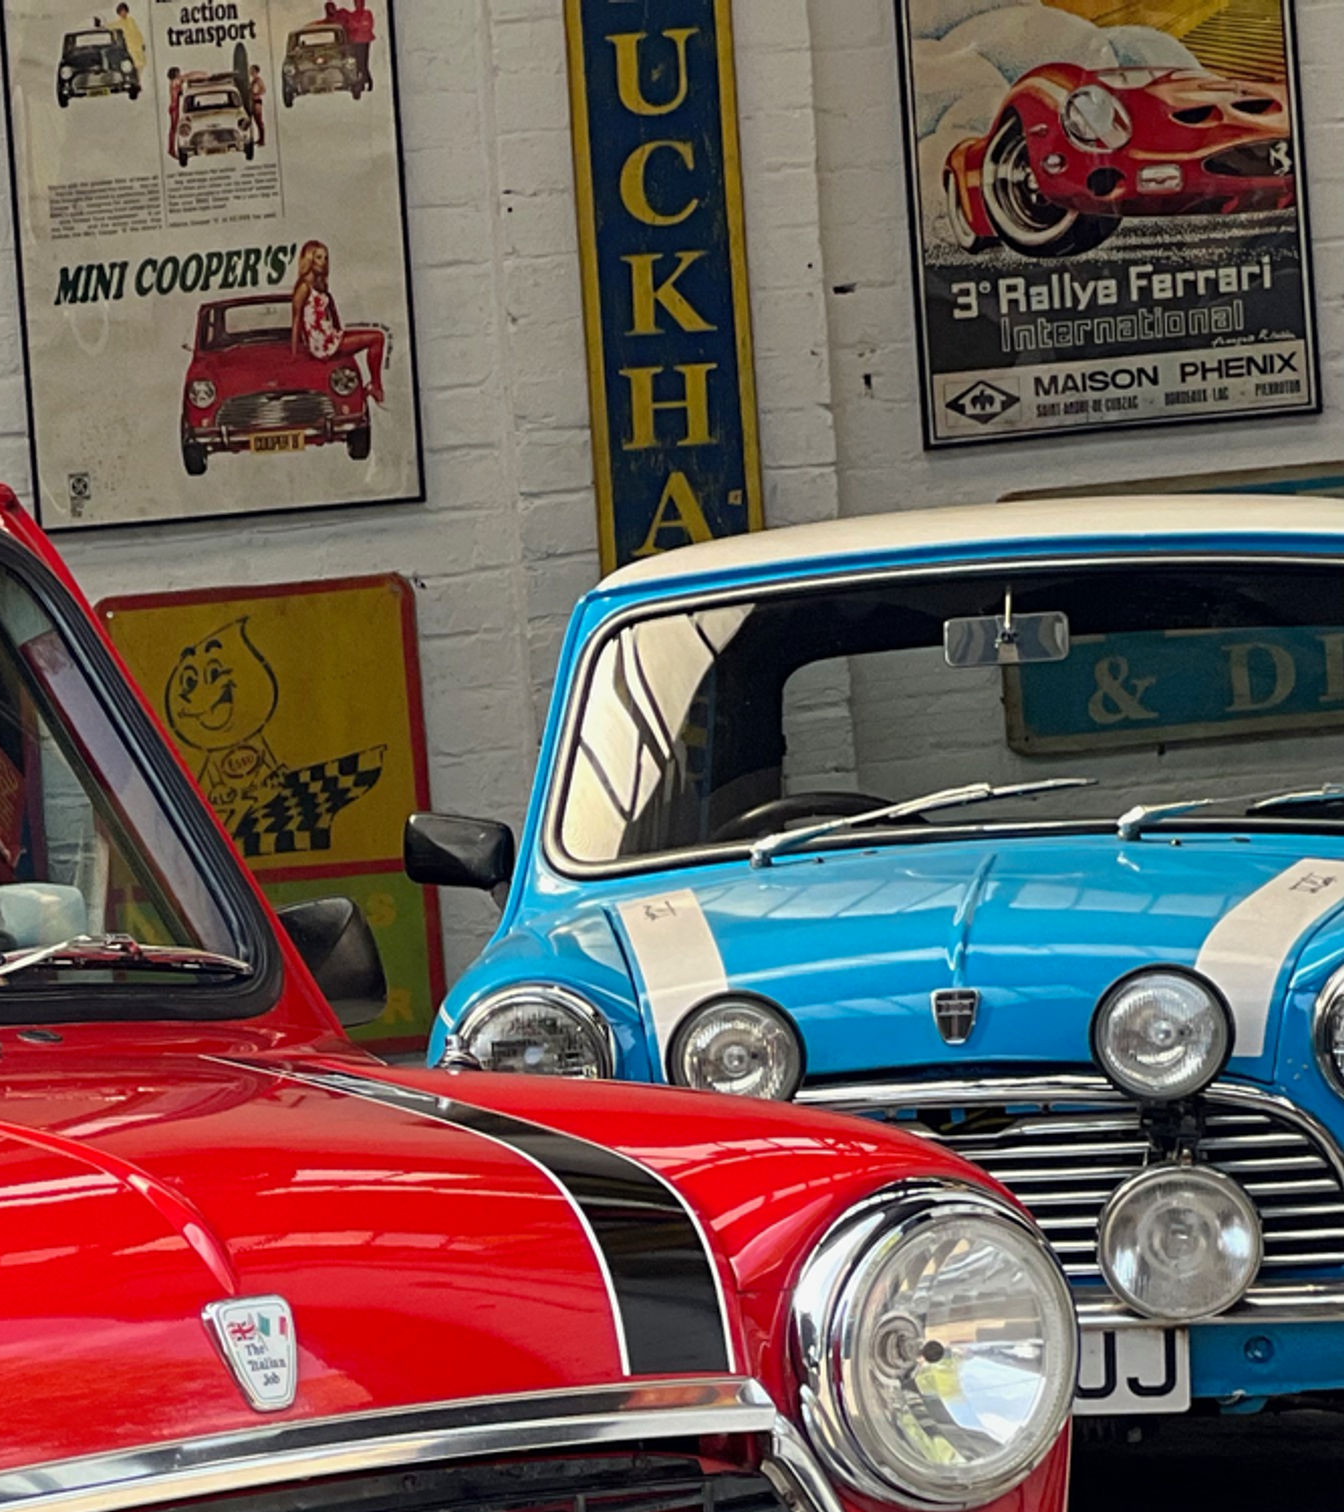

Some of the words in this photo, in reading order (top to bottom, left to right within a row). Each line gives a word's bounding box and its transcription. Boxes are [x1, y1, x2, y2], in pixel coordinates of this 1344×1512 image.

[167, 19, 256, 47] transport
[180, 0, 238, 24] action
[54, 261, 129, 306] MINI
[605, 0, 717, 556] UCKHA
[998, 274, 1118, 314] Rallye
[1129, 254, 1272, 302] Ferrari
[1001, 300, 1245, 352] International
[1034, 366, 1159, 397] MAISON
[1180, 352, 1299, 384] PHENIX
